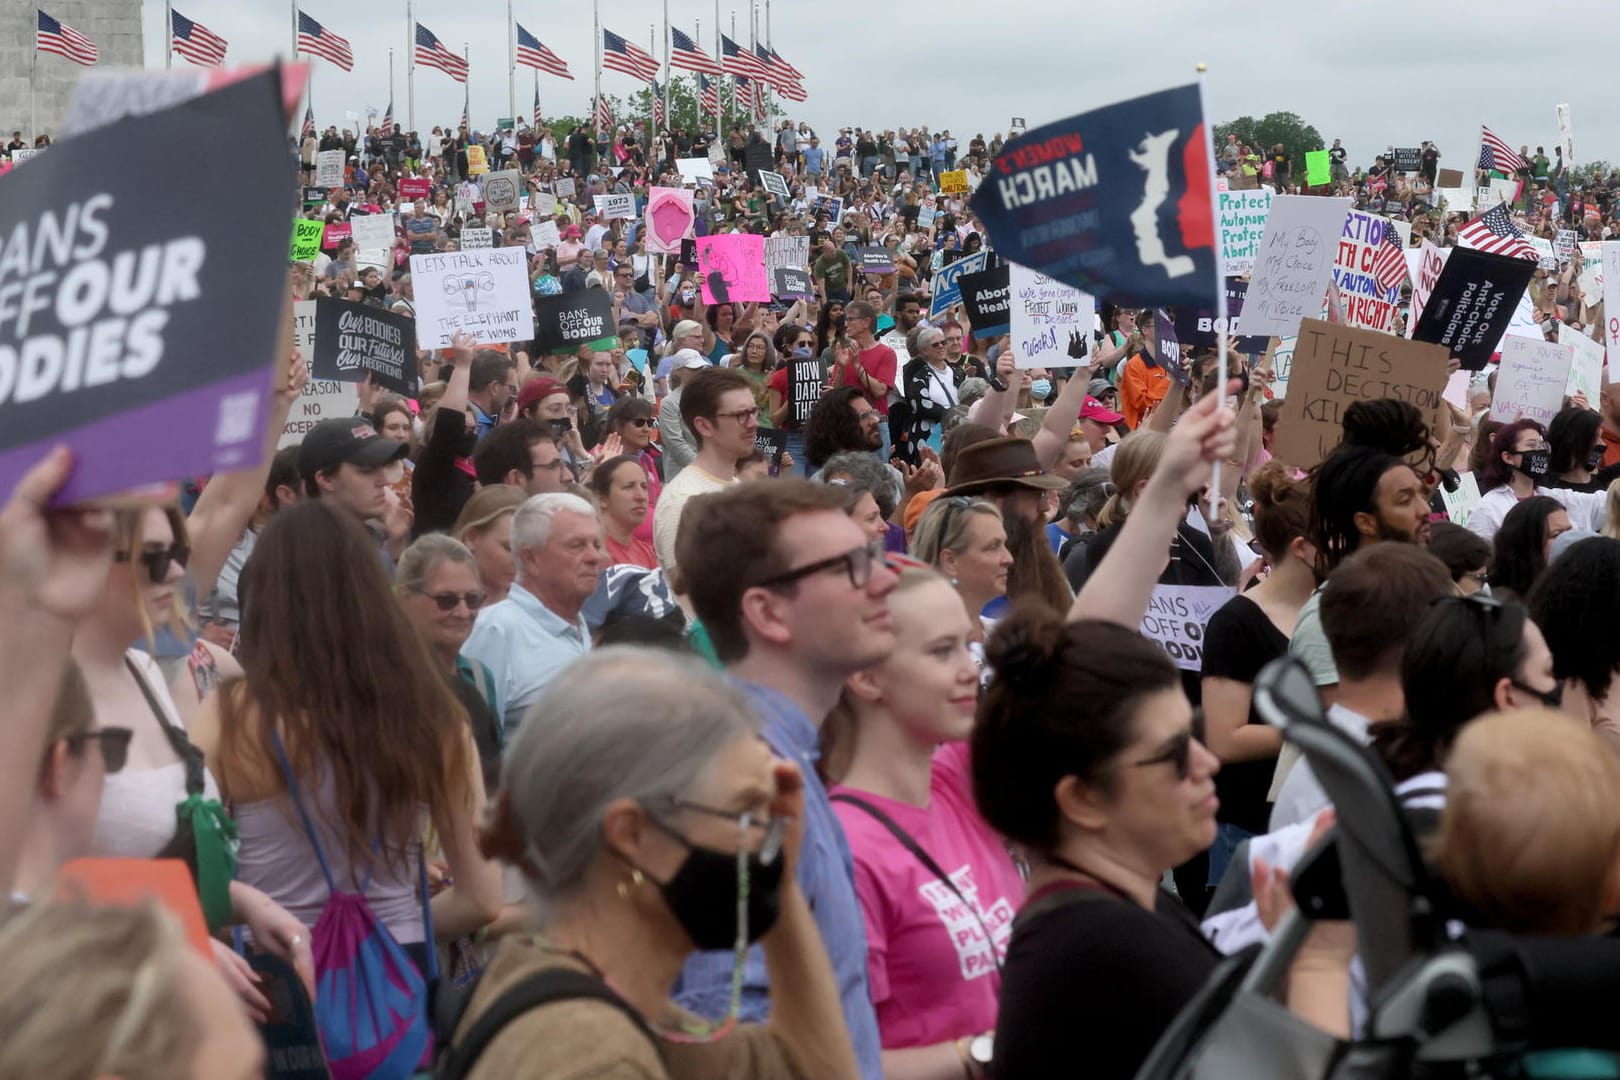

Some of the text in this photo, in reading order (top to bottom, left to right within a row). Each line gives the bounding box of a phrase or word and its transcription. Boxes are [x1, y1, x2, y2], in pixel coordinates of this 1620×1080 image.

[1219, 192, 1271, 210] Protect
[1221, 211, 1268, 227] Autonom
[1342, 212, 1387, 246] RTIO
[0, 193, 113, 282] ANS
[297, 223, 321, 238] BODY
[1222, 227, 1263, 244] Protec
[291, 245, 317, 257] CHOICE
[1223, 240, 1258, 259] Aborti
[451, 254, 483, 270] TALK
[55, 235, 206, 328] OUR
[438, 310, 521, 330] THE ELEPHANT
[559, 308, 589, 321] BANS
[560, 315, 604, 331] OFF OUR
[1441, 282, 1478, 345] Politicians
[1454, 280, 1494, 353] Anti-Choice
[1472, 291, 1505, 345] Vote Out
[338, 310, 401, 346] Our BODIES
[487, 327, 518, 340] WOMB
[561, 325, 602, 340] BODIES
[1197, 317, 1241, 337] BOD
[0, 308, 169, 405] DIES
[336, 348, 362, 368] Our
[338, 334, 368, 353] OUR
[367, 339, 405, 364] Futures
[1161, 339, 1181, 366] BODY
[1308, 331, 1393, 375] THIS
[795, 360, 820, 381] HOW
[795, 381, 823, 401] DARE
[303, 403, 321, 416] NO
[1302, 392, 1344, 426] KIL
[281, 421, 314, 434] XCEP
[1148, 596, 1189, 618] ANS
[1142, 615, 1180, 638] OFF
